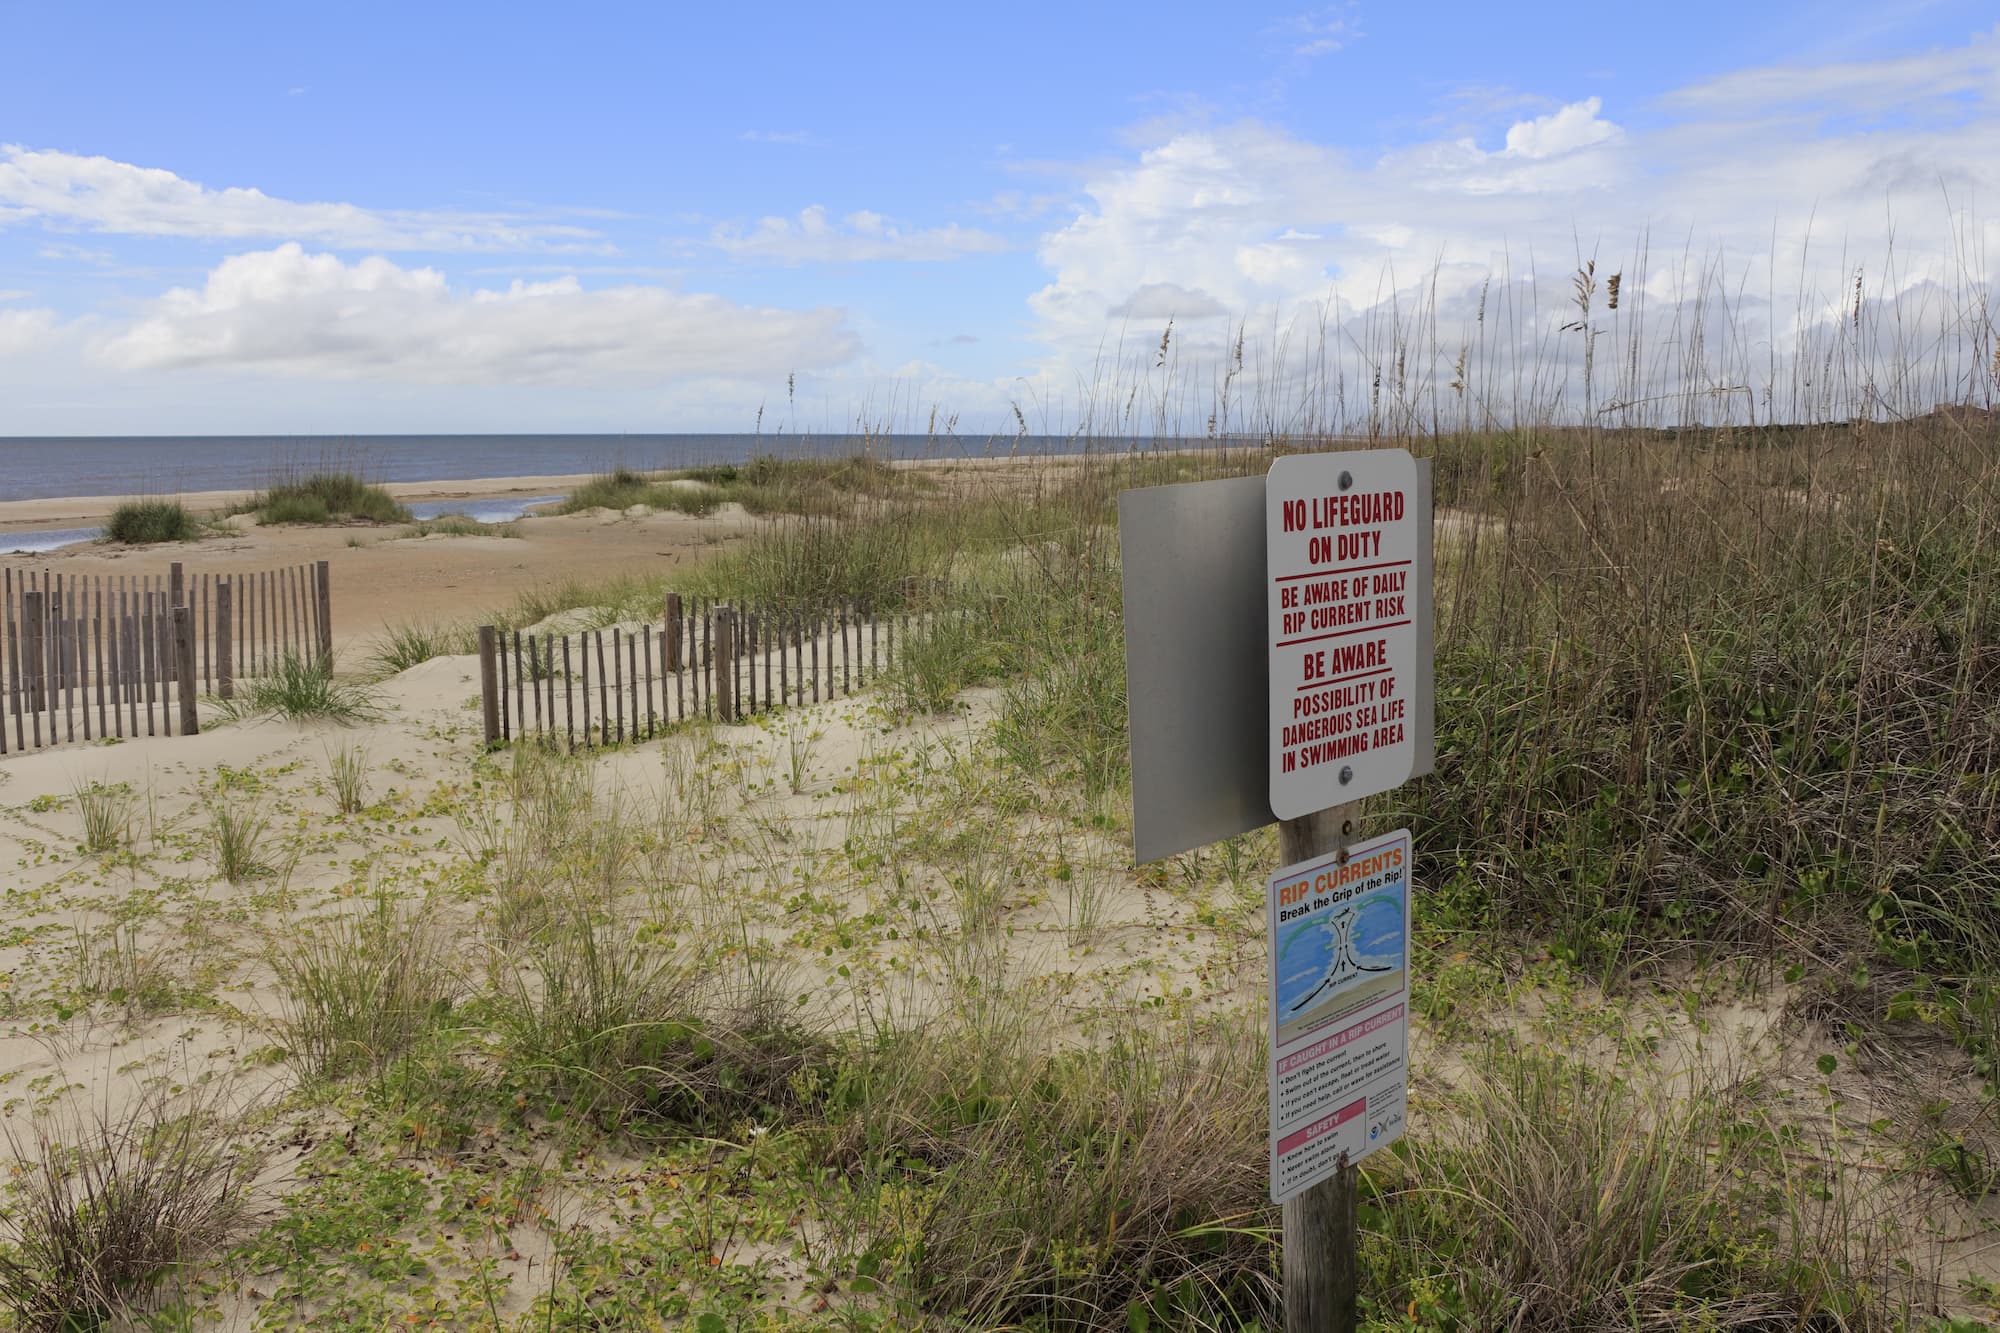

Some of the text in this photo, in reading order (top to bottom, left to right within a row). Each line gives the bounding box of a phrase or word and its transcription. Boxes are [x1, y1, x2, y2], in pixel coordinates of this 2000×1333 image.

[1283, 491, 1404, 532] NO LIFEGUARD
[1309, 530, 1381, 565] ON DUTY
[1281, 571, 1407, 609] BE AWARE OF DAILY
[1283, 595, 1405, 635] RIP CURRENT RISK
[1304, 639, 1386, 681] BE AWARE
[1294, 677, 1395, 719] POSSIBILITY OF
[1283, 699, 1404, 748] DANGEROUS SEA LIFE
[1282, 723, 1404, 773] IN SWIMMING AREA
[1279, 848, 1402, 907] RIP CURRENTS
[1280, 903, 1310, 922] Break
[1314, 897, 1330, 913] the
[1332, 888, 1353, 903] Grip
[1355, 882, 1364, 894] of
[1367, 877, 1382, 890] the
[1385, 869, 1402, 884] Rip!
[1279, 1007, 1402, 1072] IF CAUGHT IN A RIP CURRENT
[1306, 1114, 1339, 1138] SAFETY
